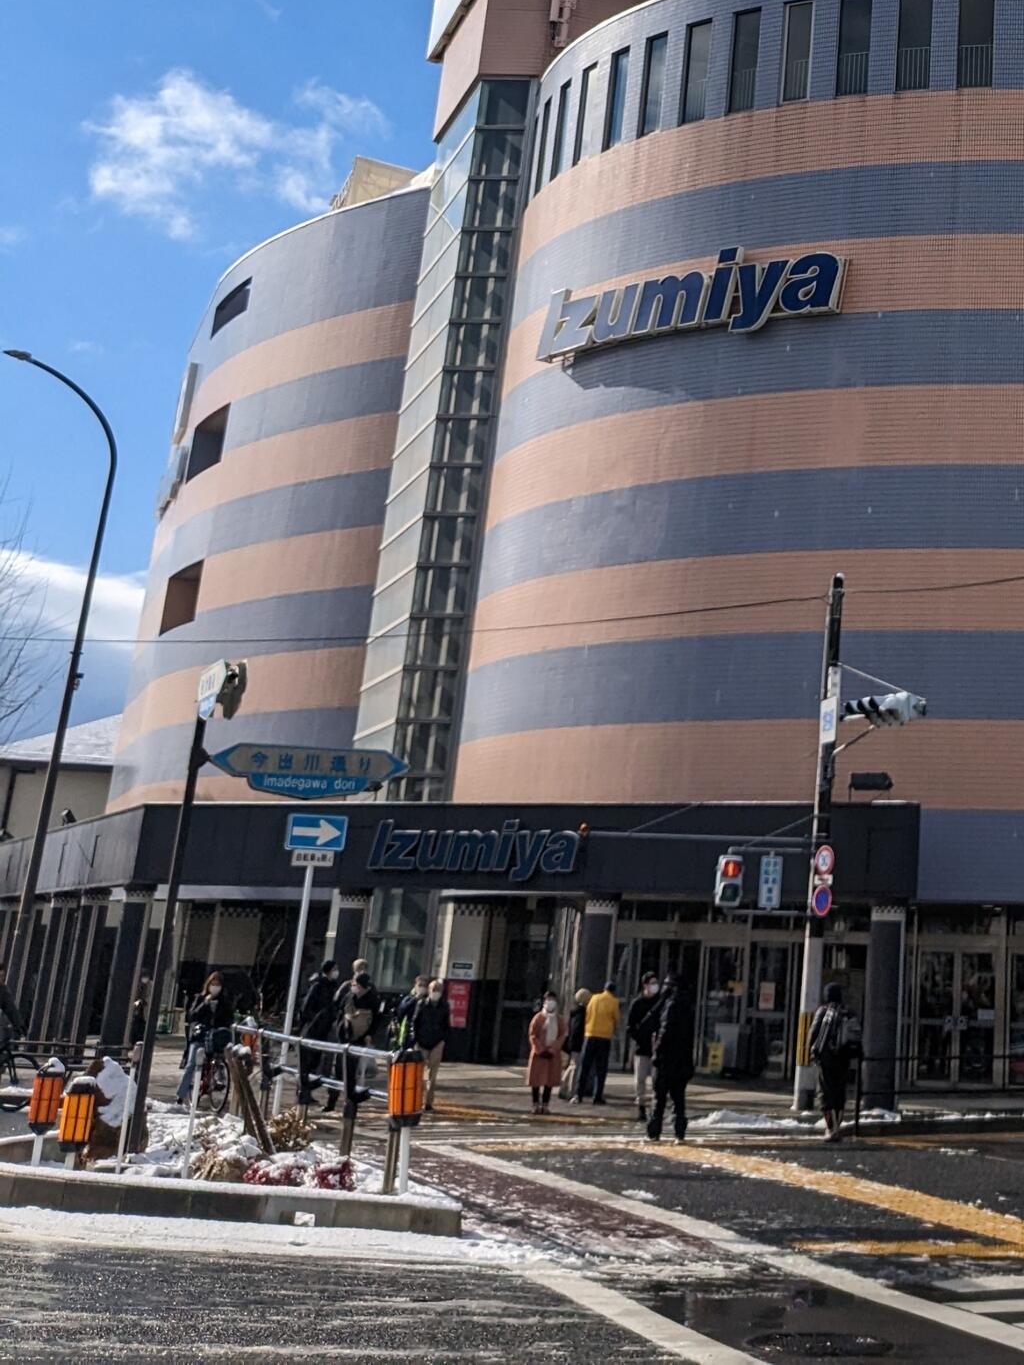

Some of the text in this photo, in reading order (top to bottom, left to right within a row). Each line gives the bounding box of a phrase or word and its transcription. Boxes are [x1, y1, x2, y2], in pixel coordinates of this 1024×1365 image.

[536, 245, 848, 363] Izumiya
[251, 750, 371, 772] 今出川通り
[263, 775, 356, 791] Imadegawa dori
[366, 818, 580, 882] Izumiya
